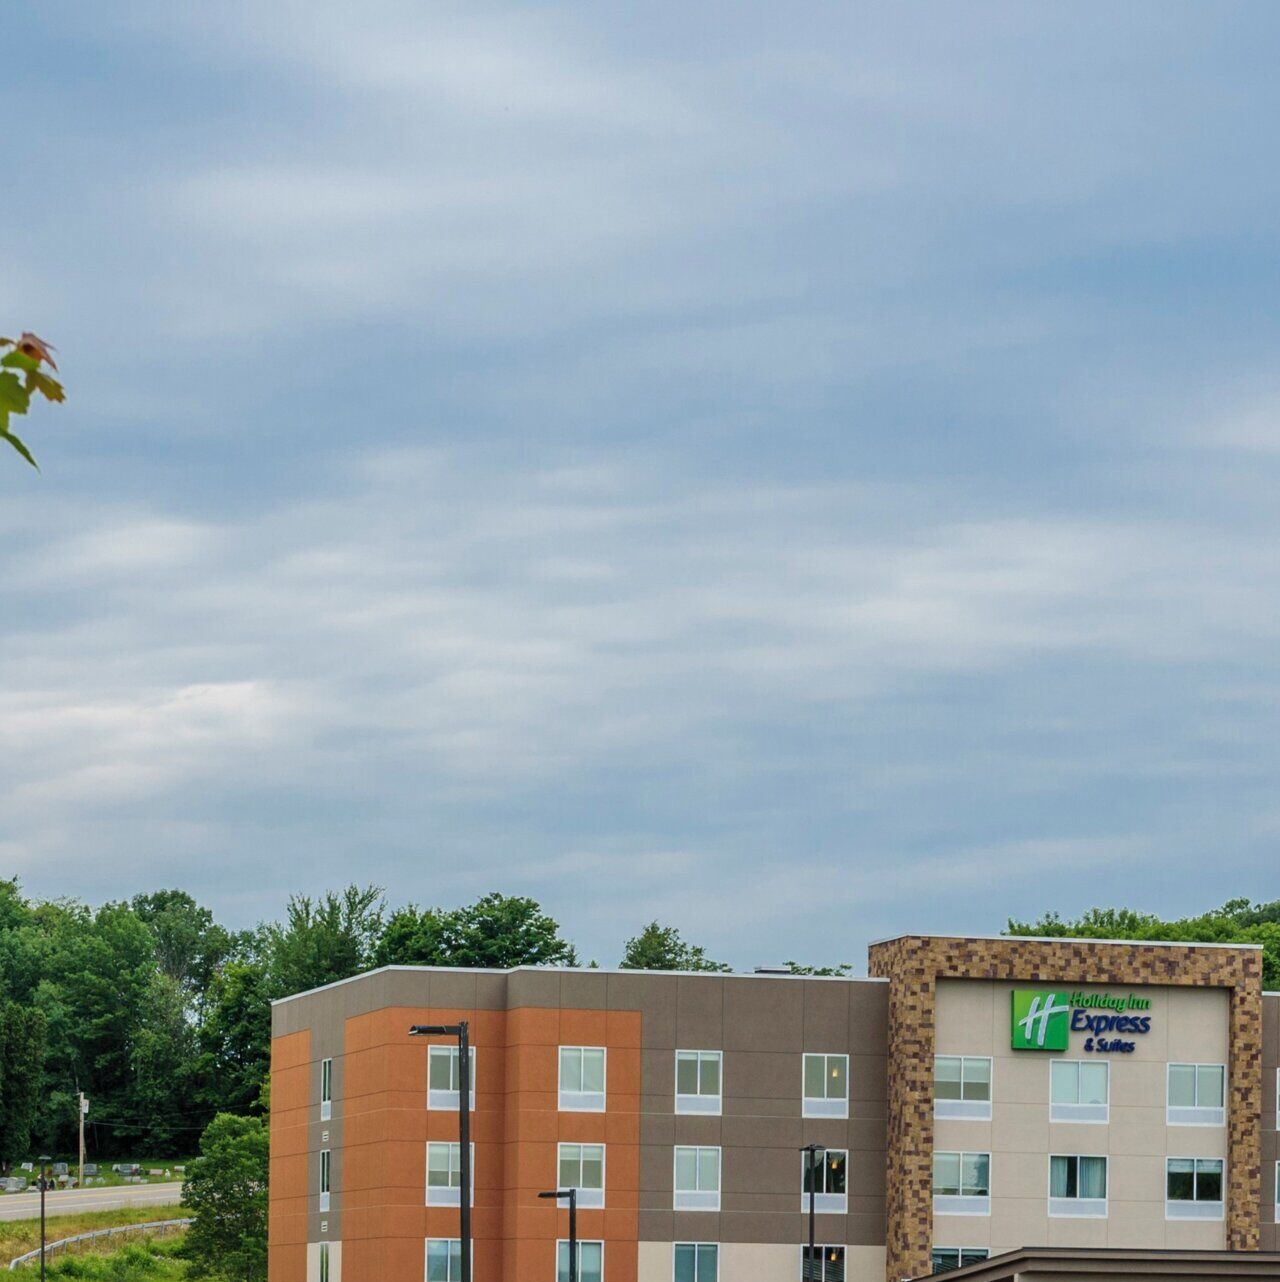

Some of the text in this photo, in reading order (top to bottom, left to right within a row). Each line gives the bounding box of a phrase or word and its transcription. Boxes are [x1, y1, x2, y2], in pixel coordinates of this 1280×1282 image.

[1070, 991, 1151, 1012] Holiday Inn
[1070, 1009, 1152, 1036] Express
[1084, 1038, 1136, 1053] & Suites
